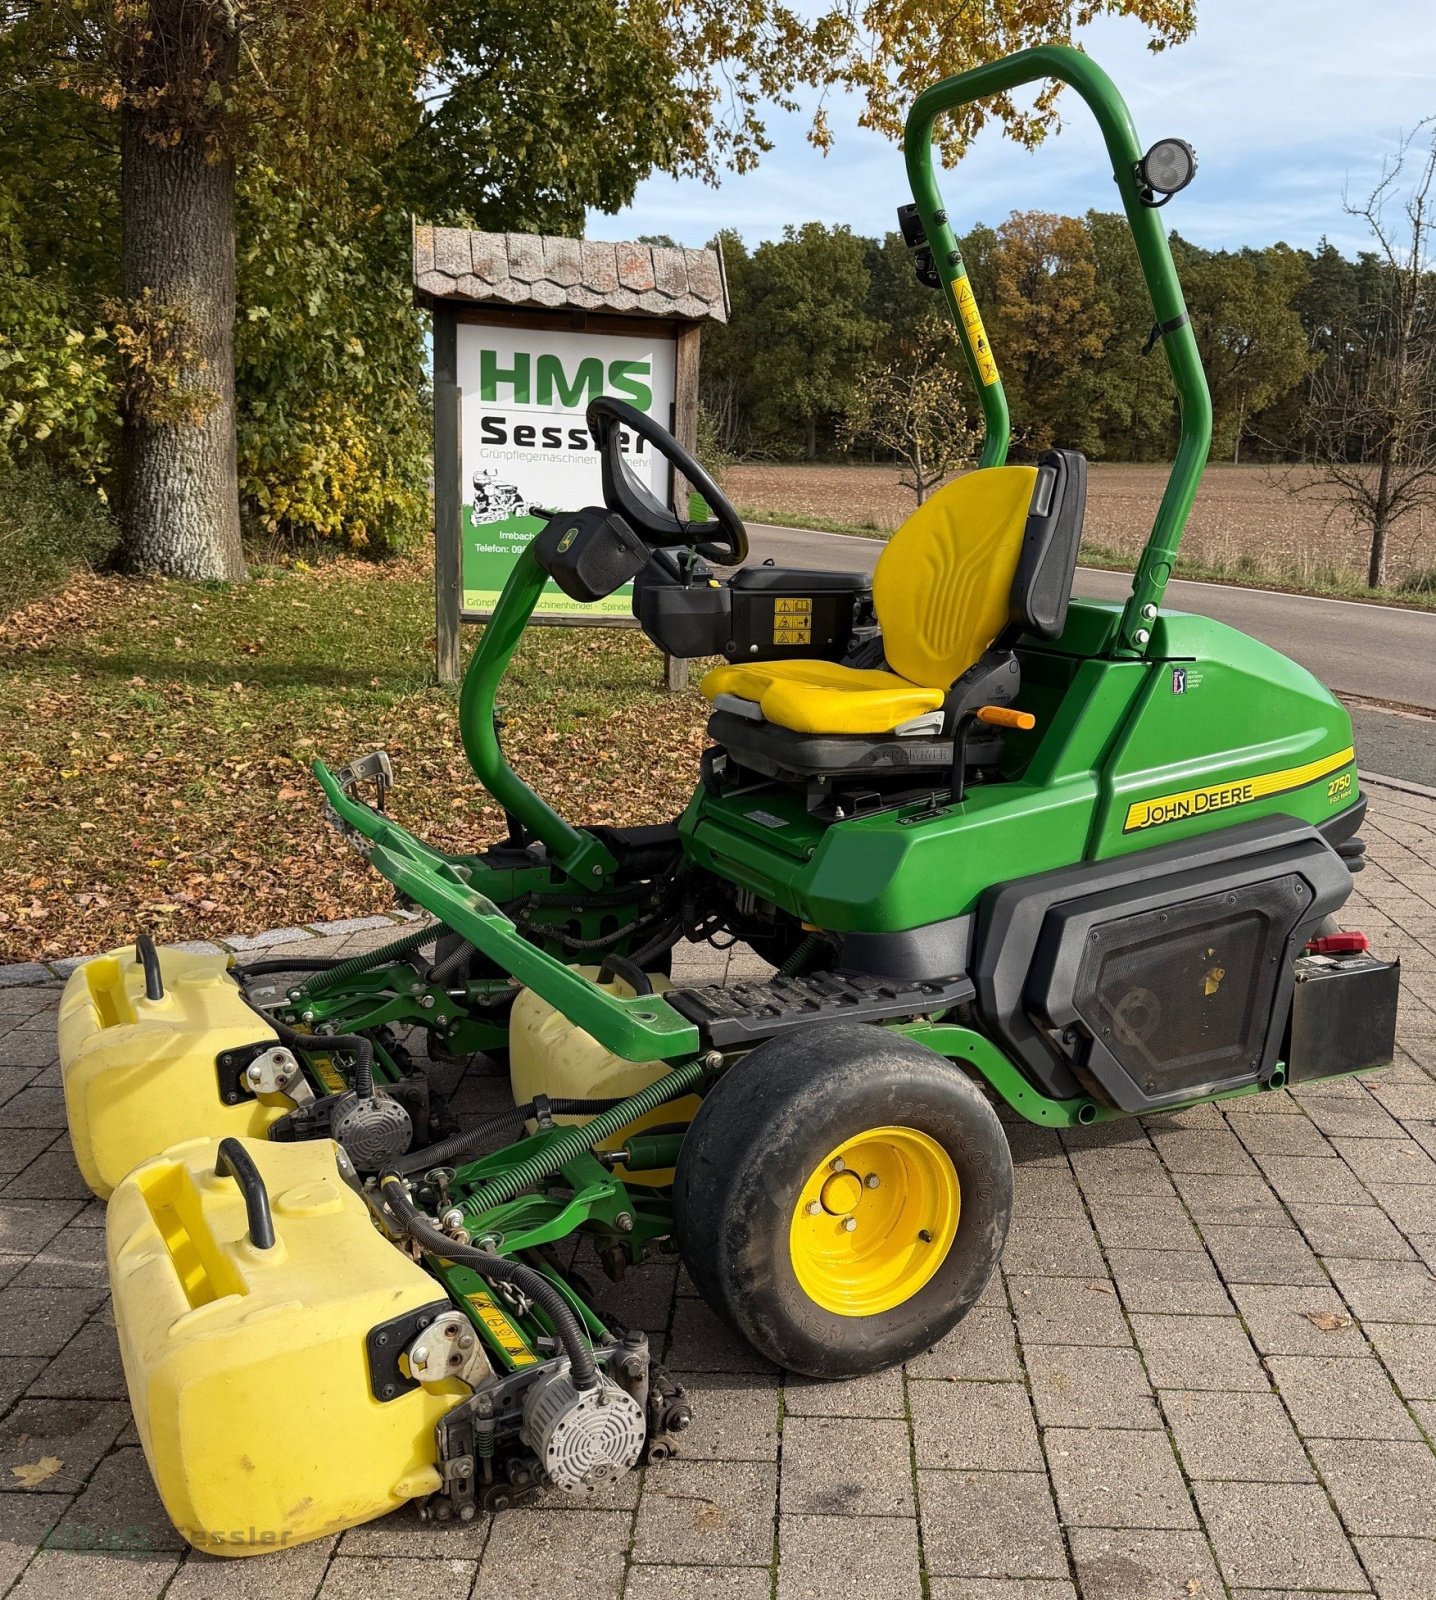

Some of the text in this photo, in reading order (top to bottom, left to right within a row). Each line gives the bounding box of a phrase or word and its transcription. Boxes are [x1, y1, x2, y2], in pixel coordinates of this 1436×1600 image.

[480, 349, 653, 412] HMS
[481, 416, 648, 454] Sesser
[480, 448, 597, 465] Grünpflegemaschinen
[475, 543, 509, 553] Telefon:
[1327, 773, 1351, 796] 2750
[1141, 784, 1253, 825] JOHN DEERE
